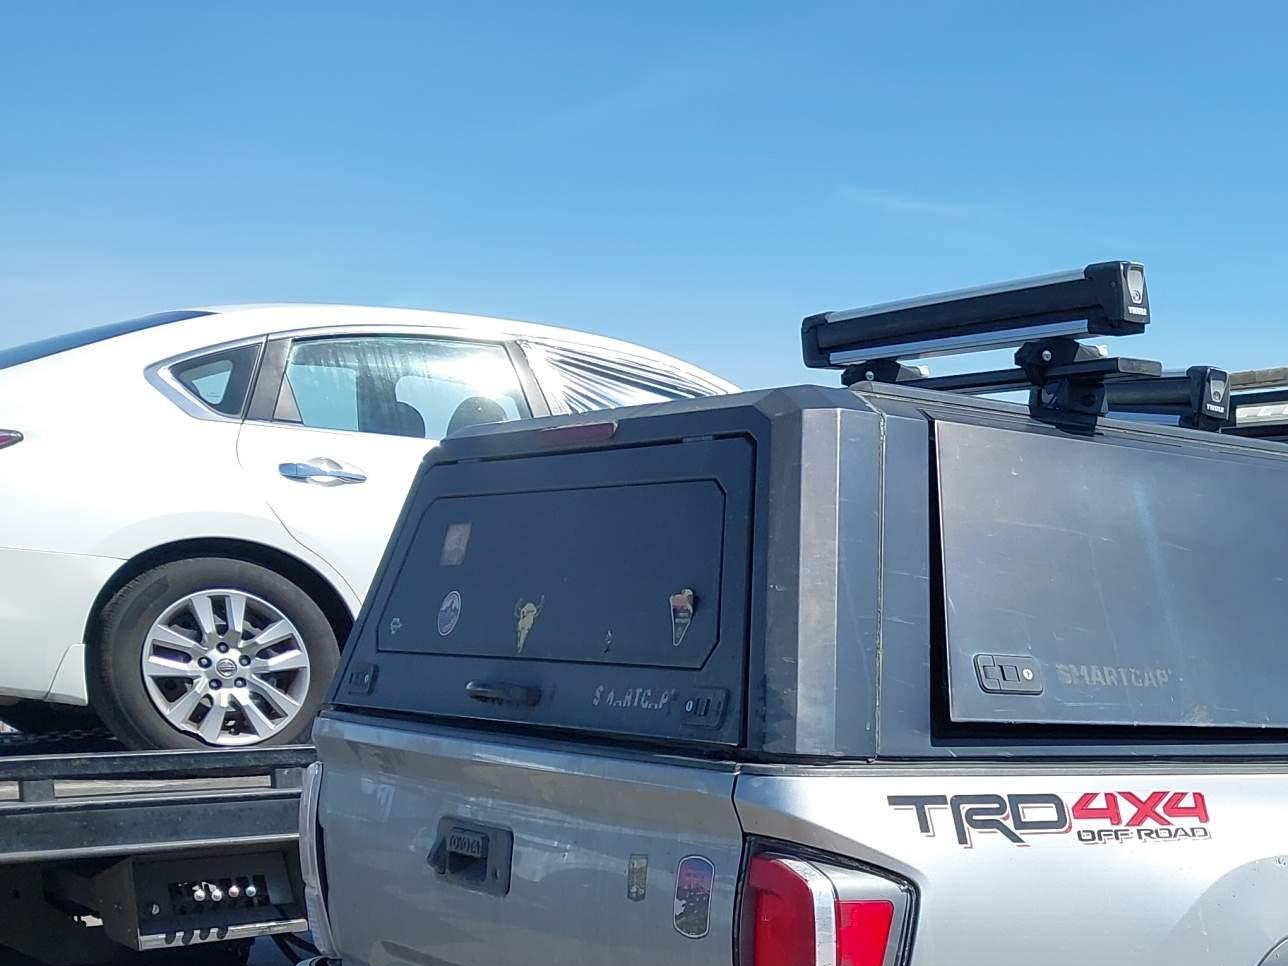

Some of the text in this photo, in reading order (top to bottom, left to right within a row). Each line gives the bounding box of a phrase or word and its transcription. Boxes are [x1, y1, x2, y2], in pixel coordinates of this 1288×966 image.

[887, 794, 1071, 848] TRD
[1076, 827, 1210, 843] OFF ROAD
